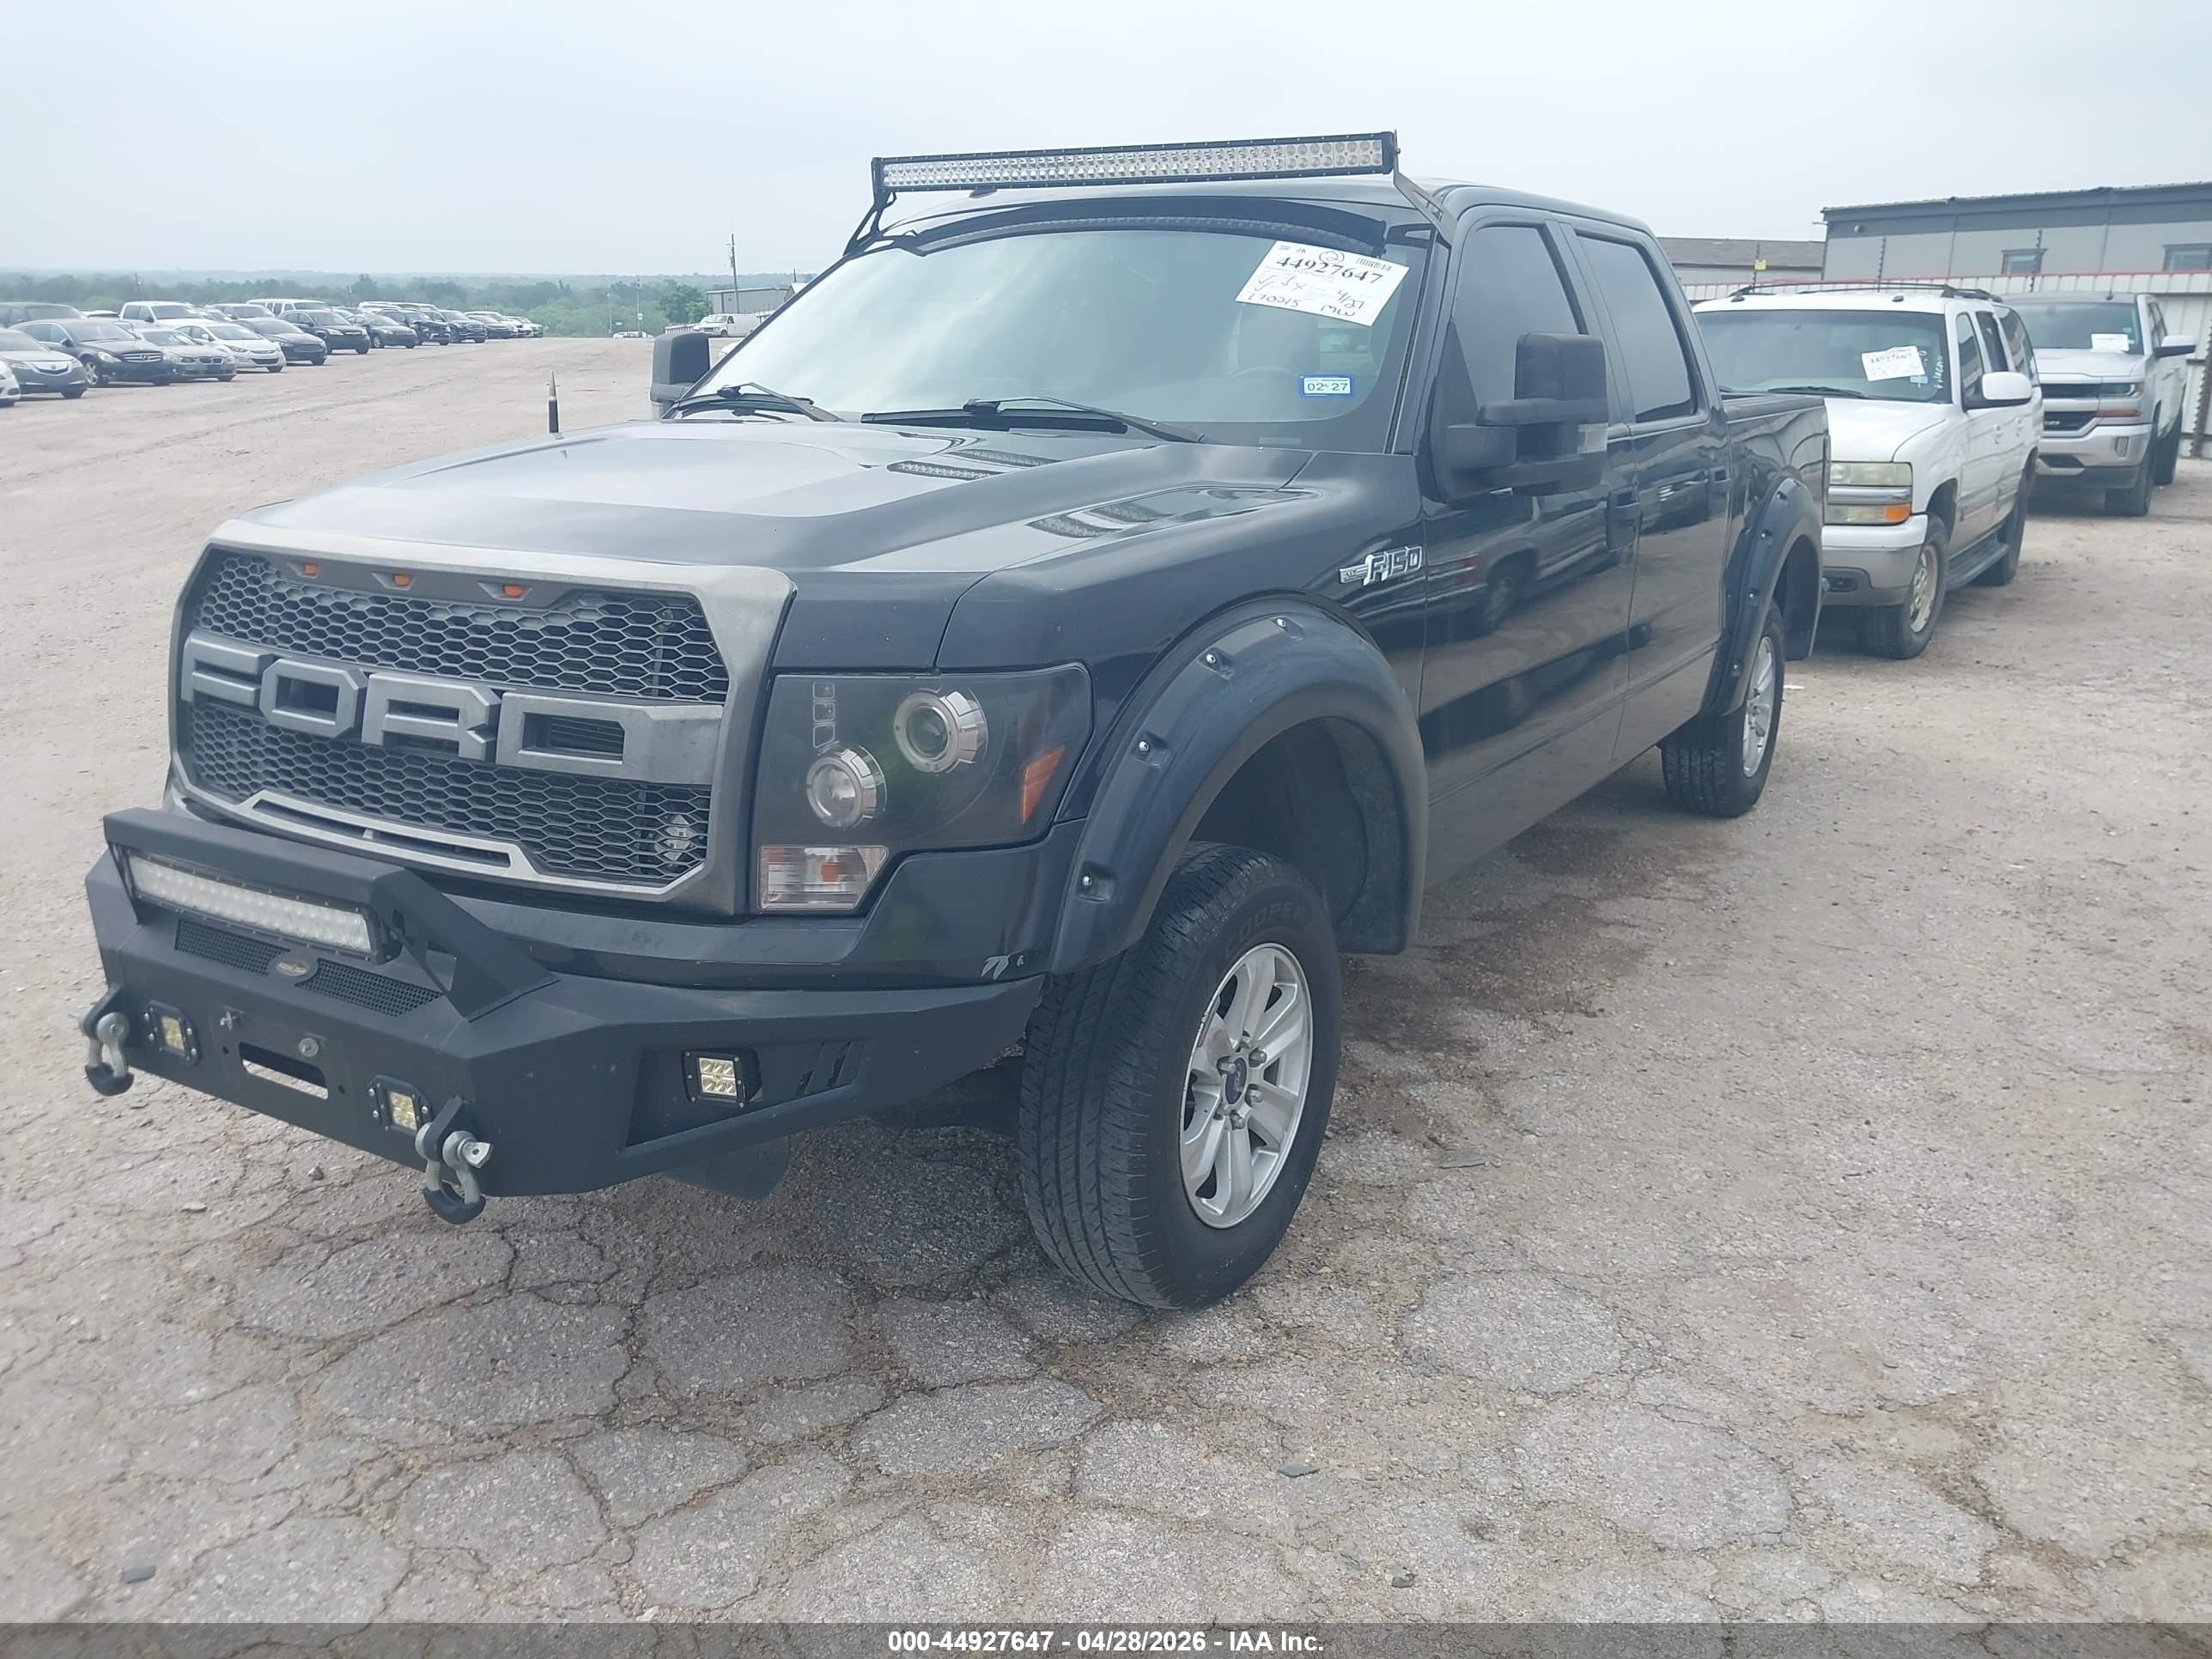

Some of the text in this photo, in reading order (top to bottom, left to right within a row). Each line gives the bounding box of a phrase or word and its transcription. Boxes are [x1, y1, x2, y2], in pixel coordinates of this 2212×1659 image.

[1276, 257, 1383, 283] 44927647
[1337, 289, 1365, 310] 4/27
[181, 632, 646, 767] FORD
